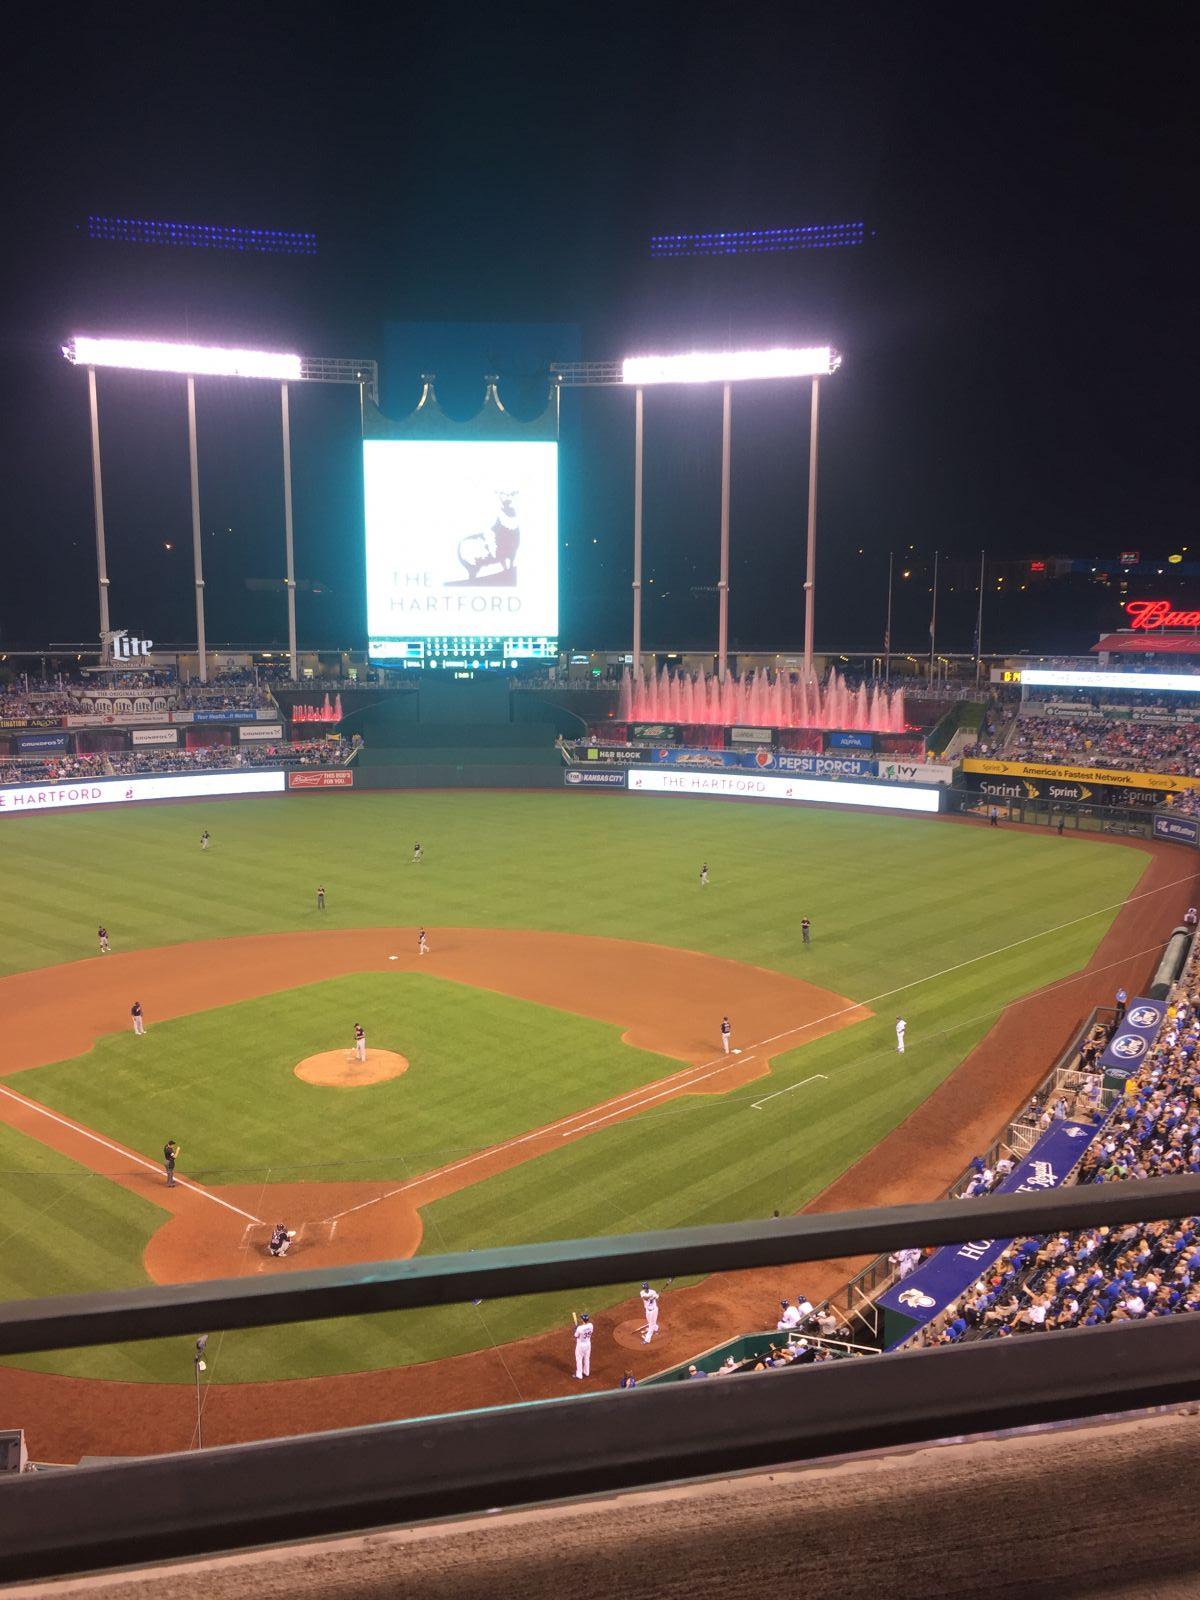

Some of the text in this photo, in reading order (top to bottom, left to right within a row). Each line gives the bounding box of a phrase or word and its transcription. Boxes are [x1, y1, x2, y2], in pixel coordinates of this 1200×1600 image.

[392, 571, 431, 587] THE
[390, 596, 522, 612] HARTFORD
[112, 636, 153, 662] Lite
[1054, 708, 1104, 718] Commerce Bank
[1140, 713, 1195, 723] Commerce Bank
[616, 751, 641, 759] BLOCK
[779, 757, 861, 773] PEPSI PORCH
[897, 765, 917, 777] Ivy
[583, 774, 624, 782] KANSAS CITY
[1023, 767, 1062, 776] America's
[1064, 769, 1094, 779] Fastest
[663, 776, 766, 792] THE HARTFORD
[979, 781, 1021, 797] Sprint
[14, 788, 102, 806] HARTFORD
[1048, 785, 1078, 798] Sprint
